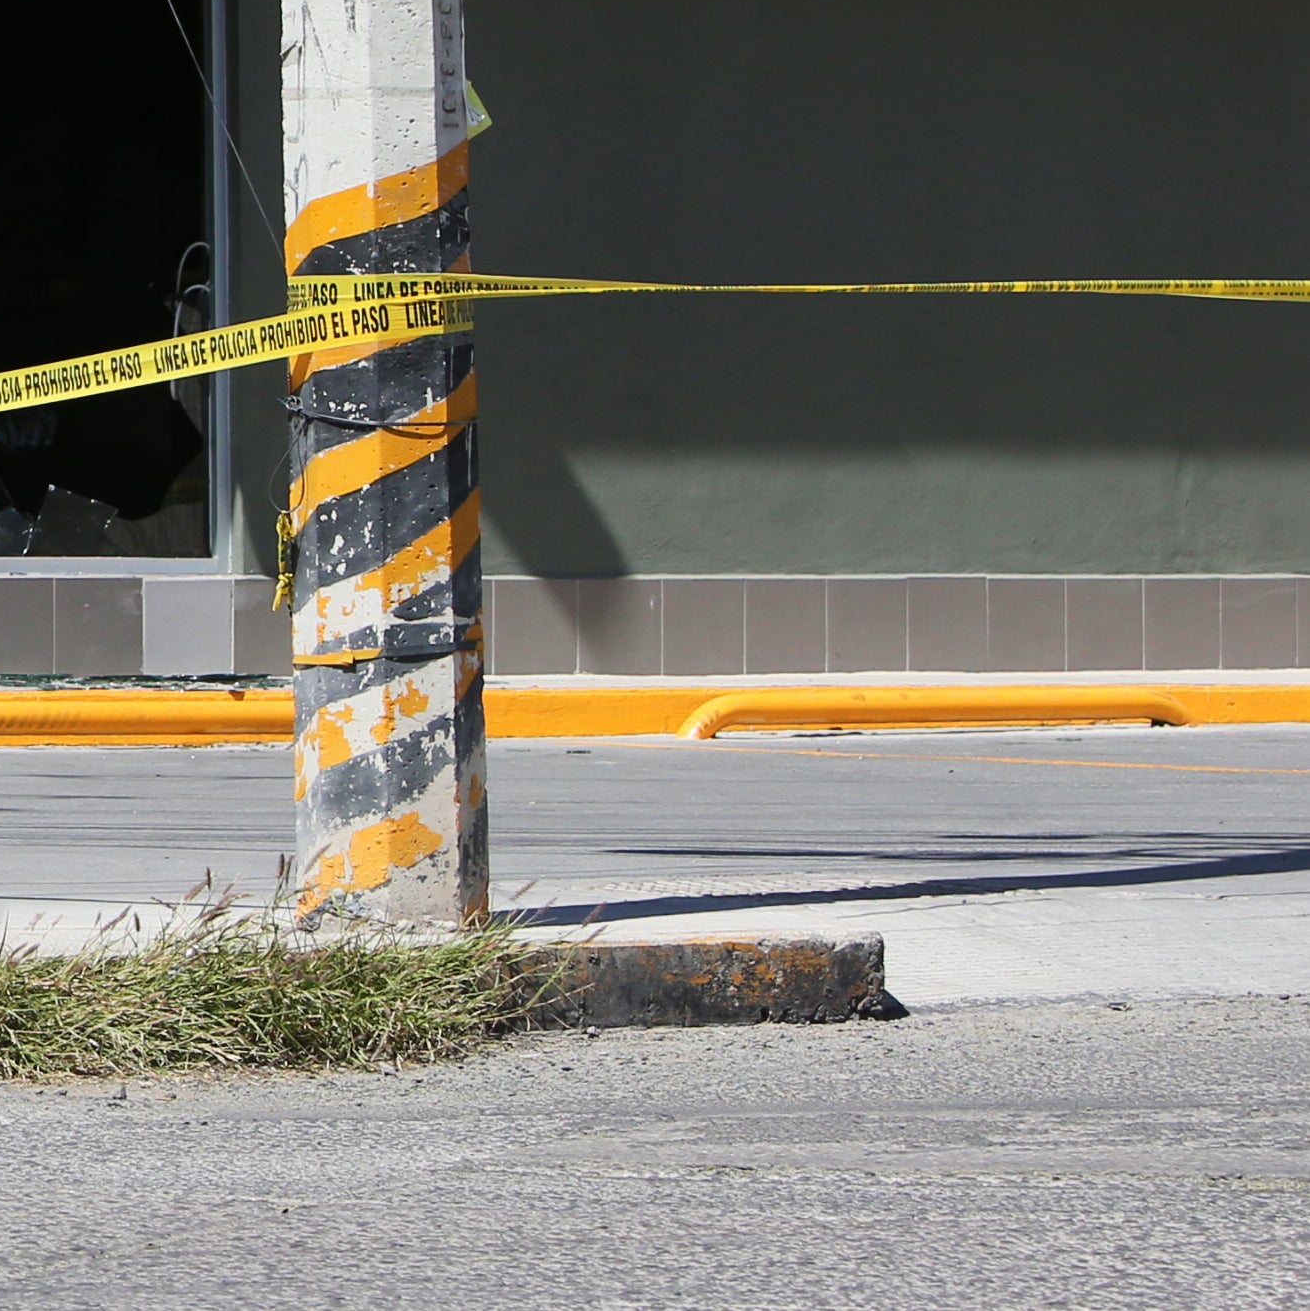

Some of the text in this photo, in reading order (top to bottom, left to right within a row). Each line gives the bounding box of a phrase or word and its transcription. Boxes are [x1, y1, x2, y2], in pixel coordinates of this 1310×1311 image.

[354, 281, 395, 302] LINEA
[399, 280, 419, 297] DE
[25, 362, 92, 398] PROHIBIDO
[95, 360, 110, 386] EL
[112, 352, 142, 381] PASO
[153, 343, 189, 374] LINEA
[191, 338, 207, 366] DE
[210, 328, 258, 362] POLICIA
[260, 312, 328, 353] PROHIBIDO
[331, 312, 349, 339] EL
[351, 304, 390, 335] PASO
[405, 299, 445, 329] LINEA
